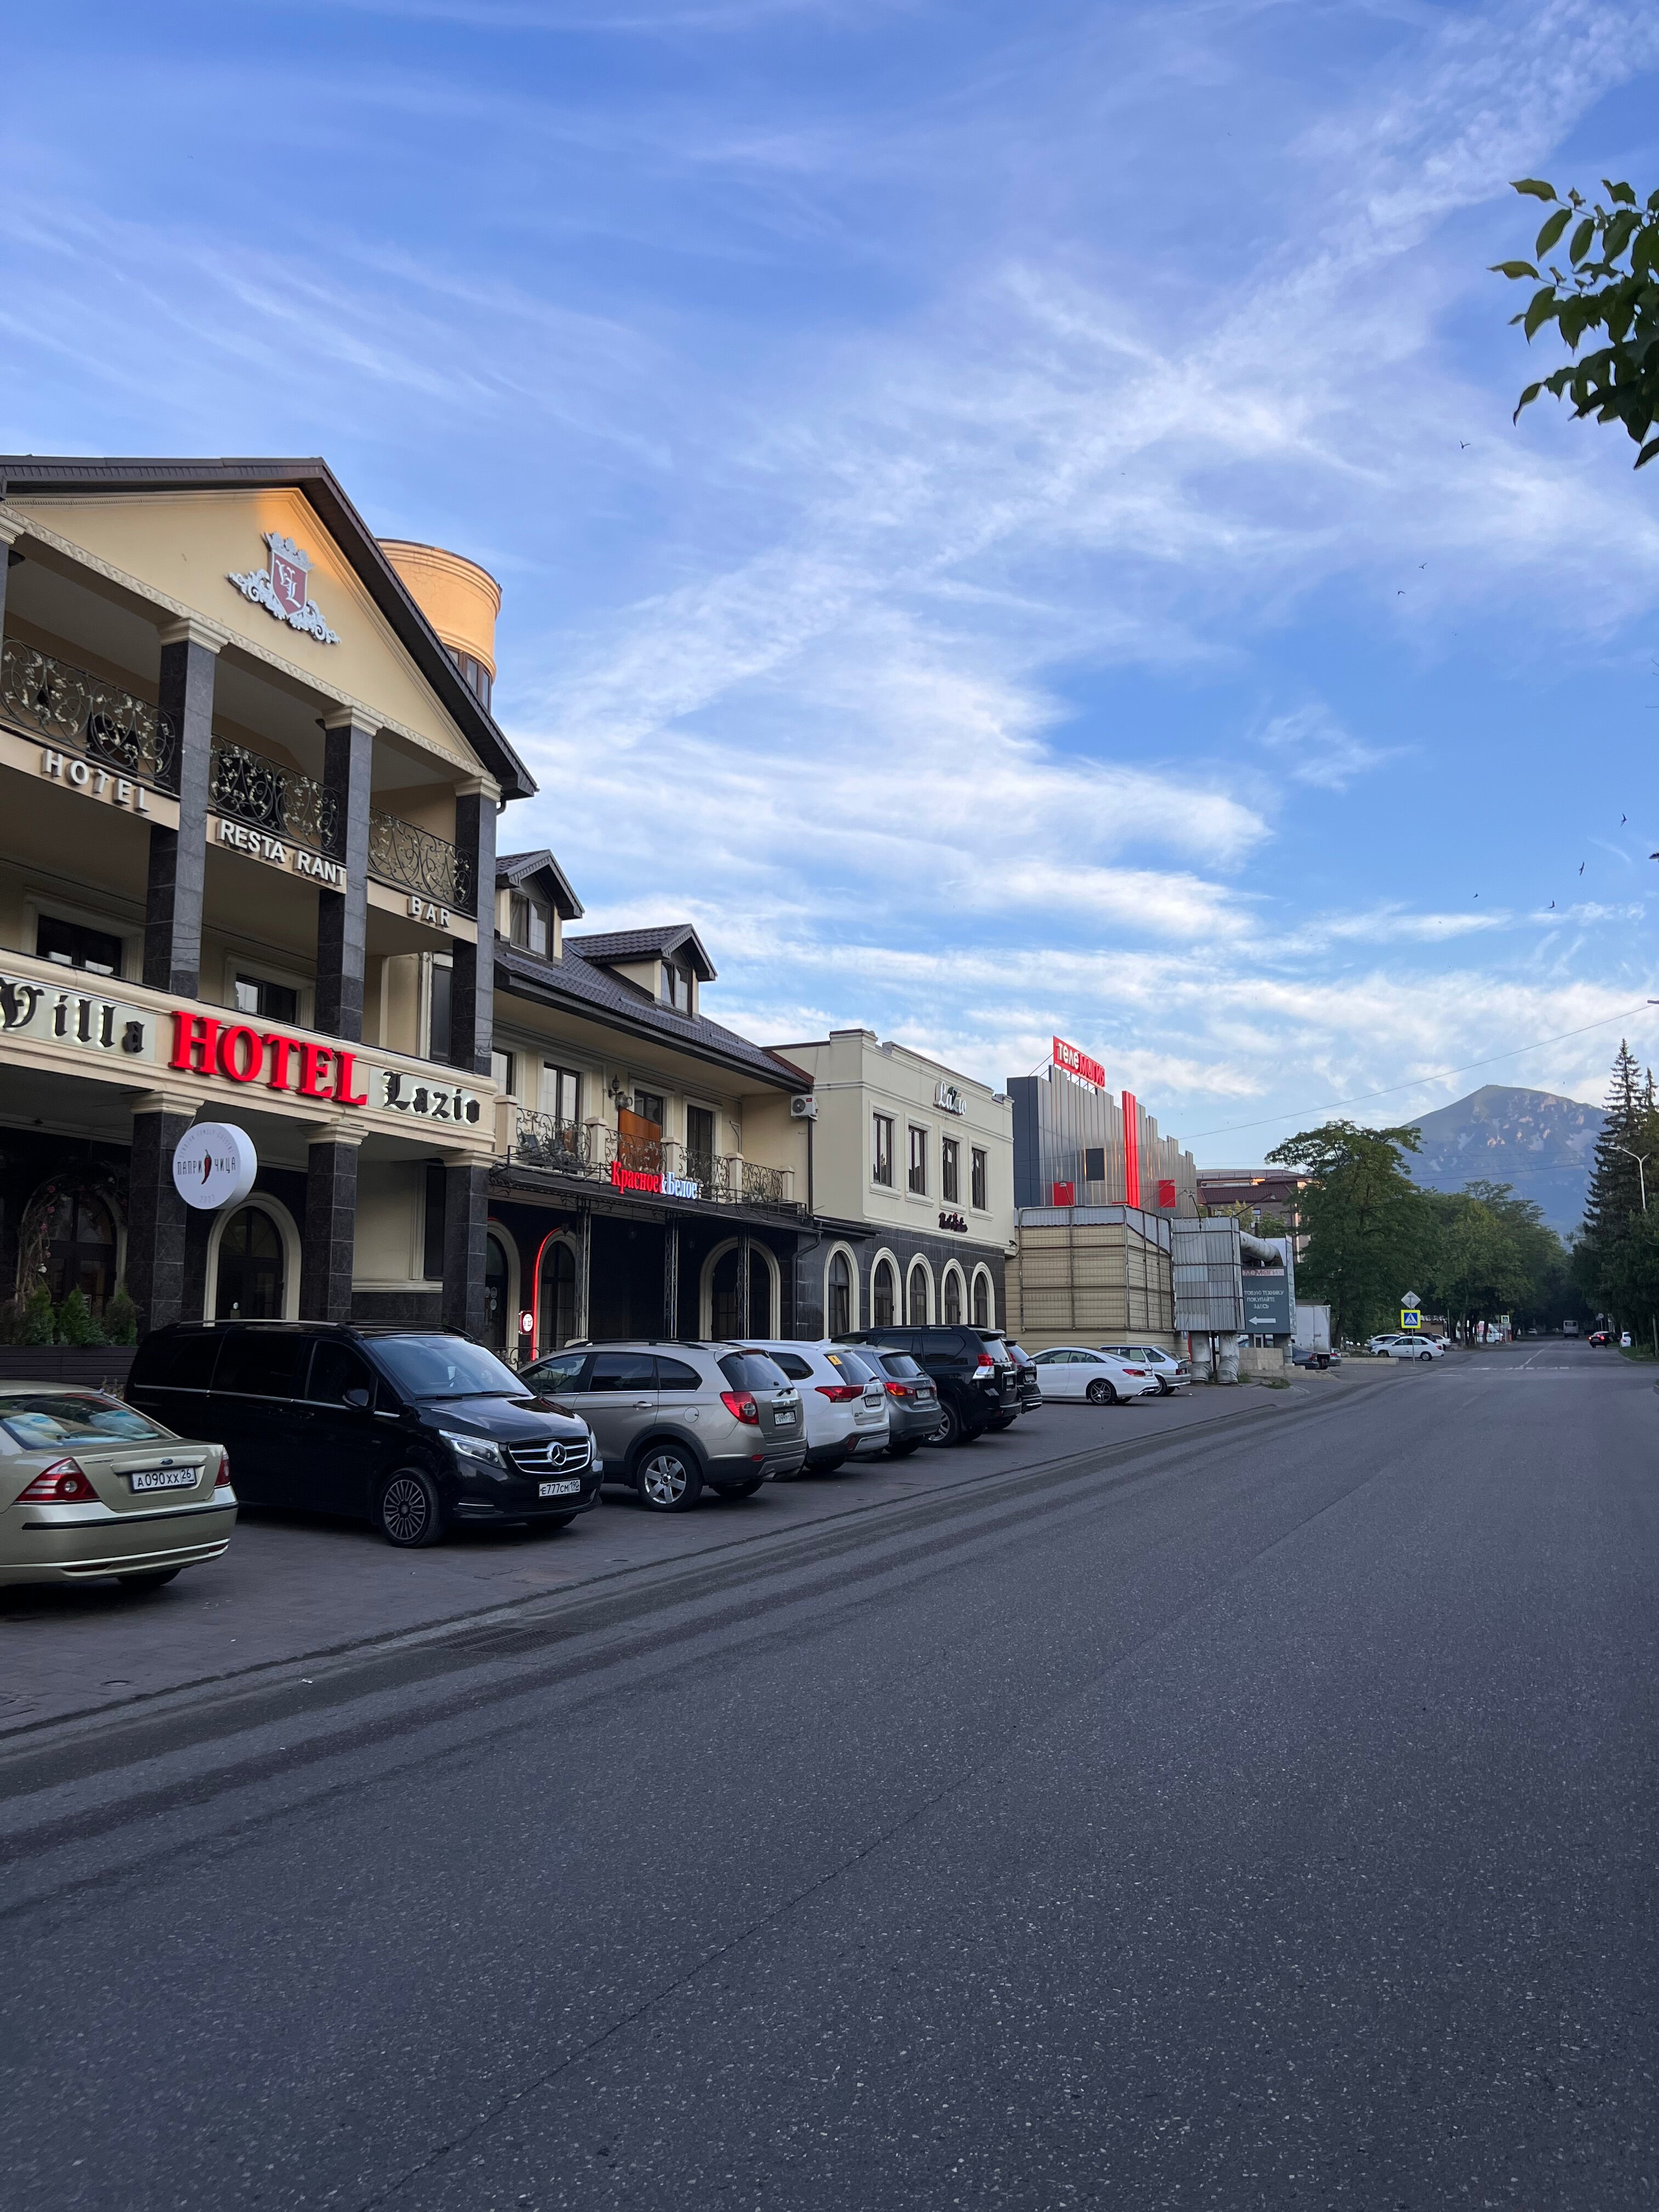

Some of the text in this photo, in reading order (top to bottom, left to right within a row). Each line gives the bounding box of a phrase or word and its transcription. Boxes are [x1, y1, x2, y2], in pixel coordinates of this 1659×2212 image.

[43, 749, 150, 812] HOTEL
[408, 895, 450, 928] BAR
[0, 978, 145, 1053] Villa
[168, 1011, 368, 1106] HOTEL
[383, 1071, 481, 1124] Lazio
[181, 1468, 191, 1479] 26
